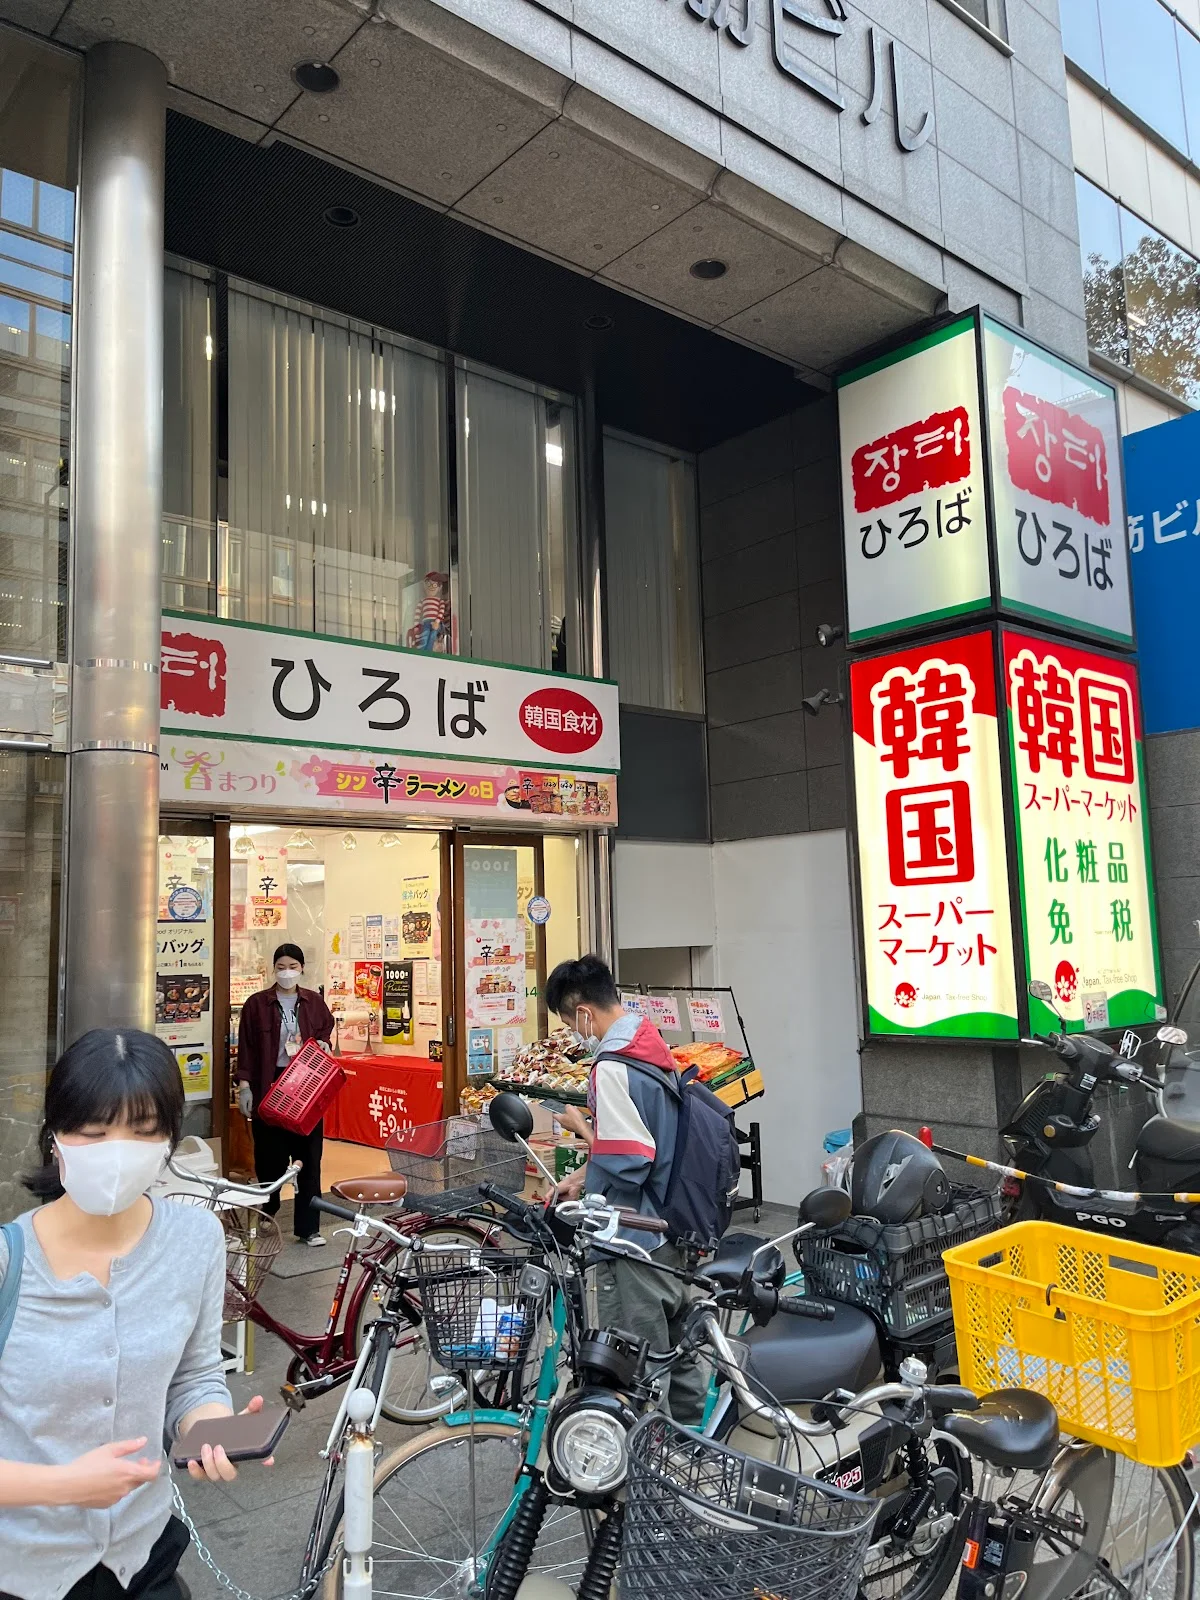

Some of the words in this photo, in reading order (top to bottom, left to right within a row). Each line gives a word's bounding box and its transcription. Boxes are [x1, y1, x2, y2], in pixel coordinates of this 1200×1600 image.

[863, 418, 962, 493] 장터
[1015, 401, 1103, 491] 장터
[860, 486, 973, 559] ひろば
[1014, 508, 1114, 591] ひろば
[269, 657, 489, 740] ひろば
[524, 704, 598, 735] 韓国食材
[1014, 657, 1135, 785] 韓国
[181, 754, 277, 795] 春まつり
[878, 667, 975, 887] 韓国
[1024, 783, 1138, 824] スーパーマーケット
[1044, 837, 1129, 884] 化粧品
[258, 876, 278, 898] 辛
[878, 896, 995, 931] スーパー
[1046, 898, 1134, 946] 免税
[878, 932, 998, 967] マーケット
[1075, 1211, 1127, 1228] PGO
[835, 1466, 862, 1491] 125
